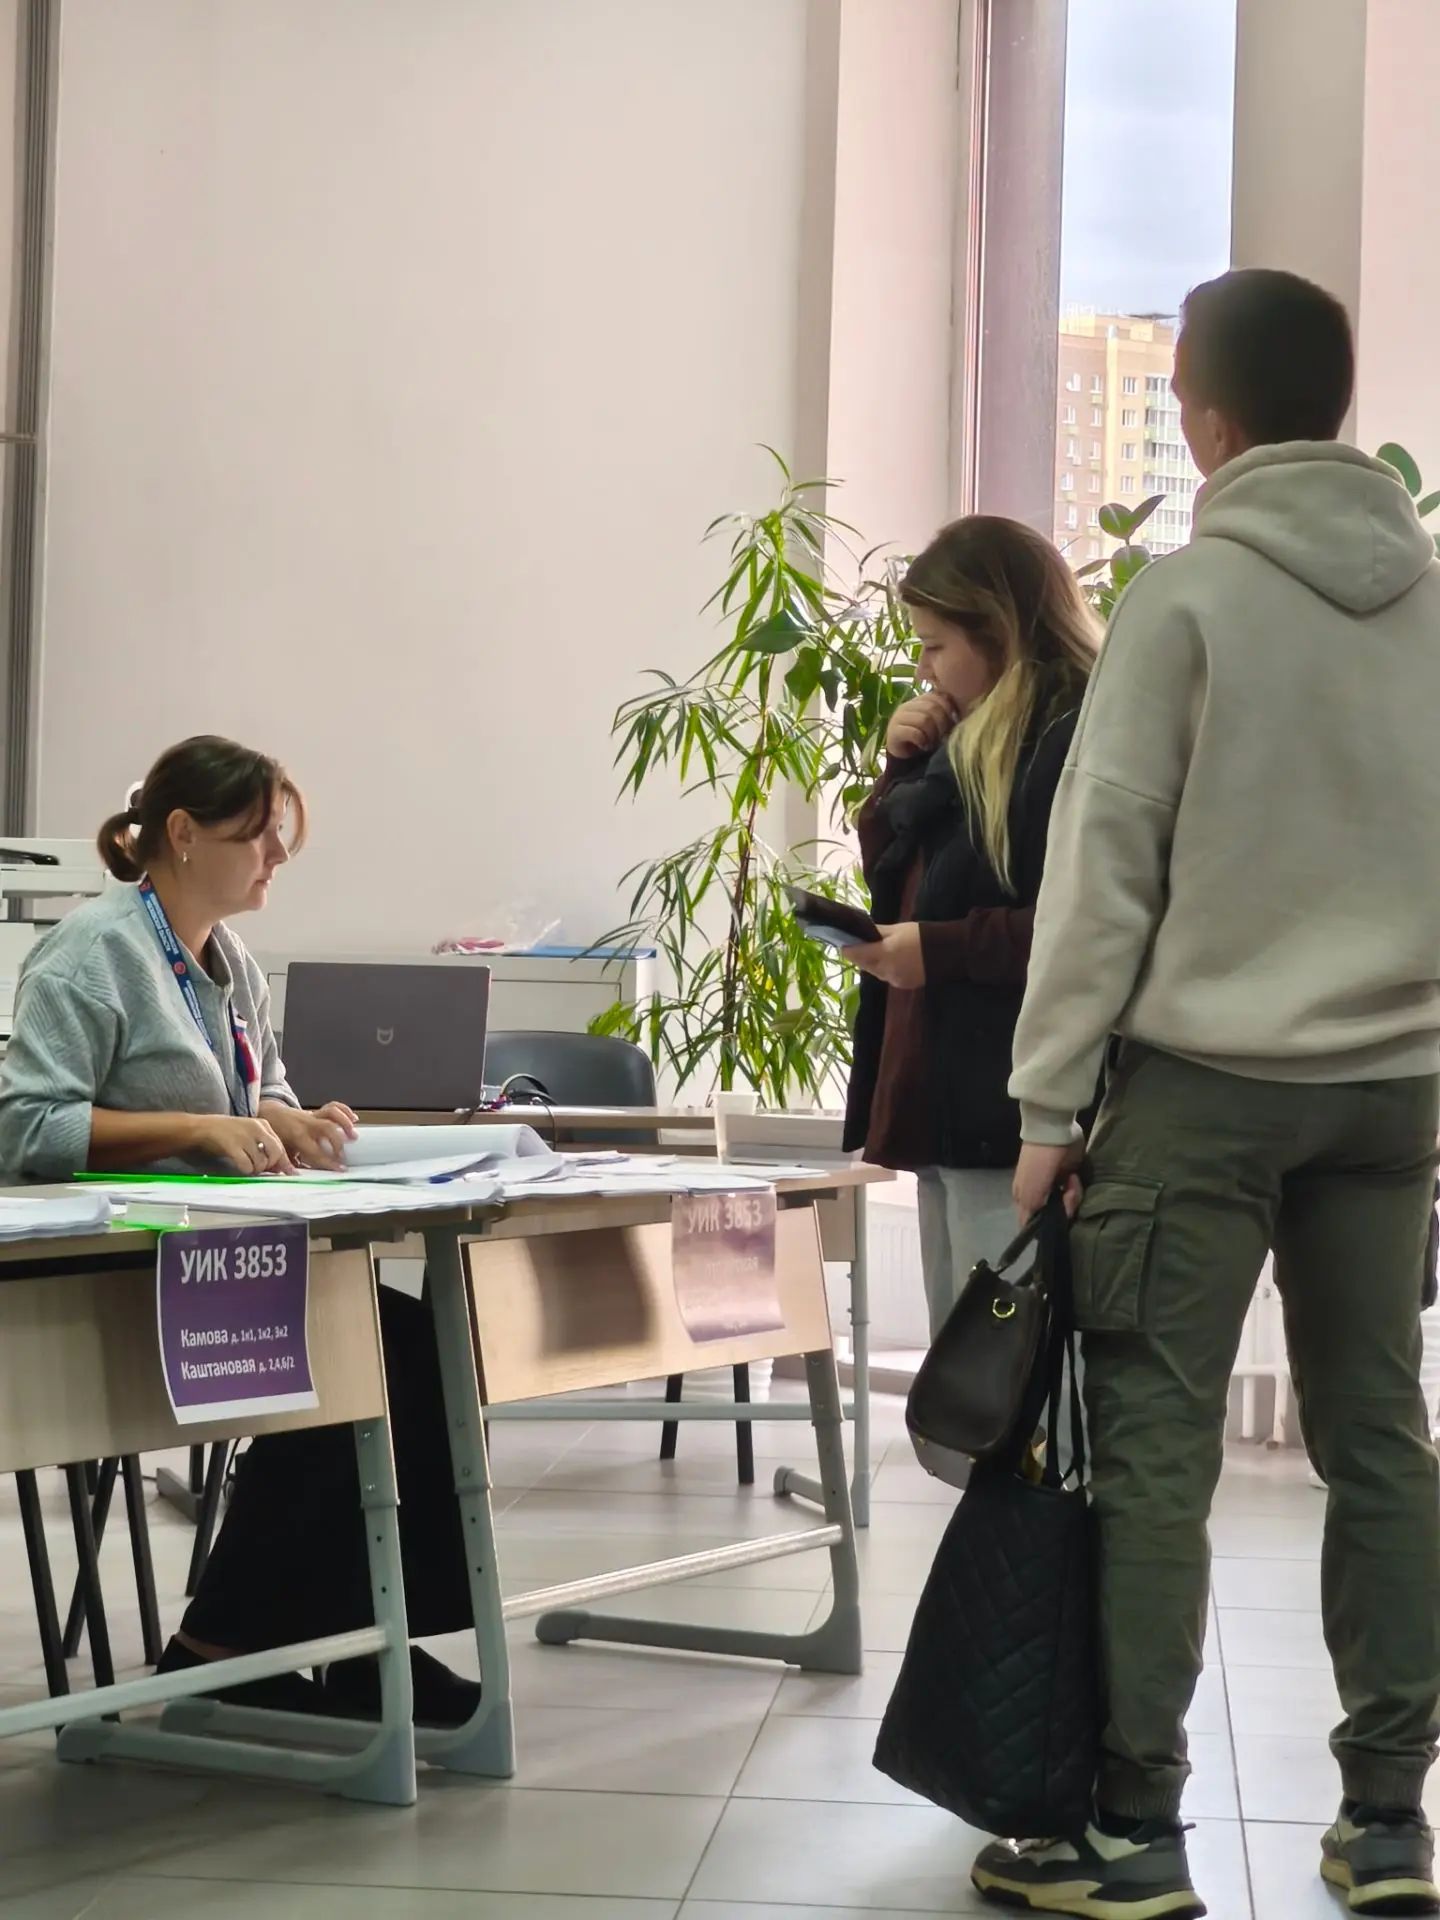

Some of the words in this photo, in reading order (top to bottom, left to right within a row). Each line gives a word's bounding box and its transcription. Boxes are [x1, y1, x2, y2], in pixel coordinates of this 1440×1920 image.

[688, 1205, 720, 1233] УИК
[724, 1200, 763, 1230] 3853
[181, 1248, 228, 1284] УИК
[234, 1244, 287, 1279] 3853
[181, 1328, 228, 1347] Камова
[181, 1359, 256, 1379] Каштановая
